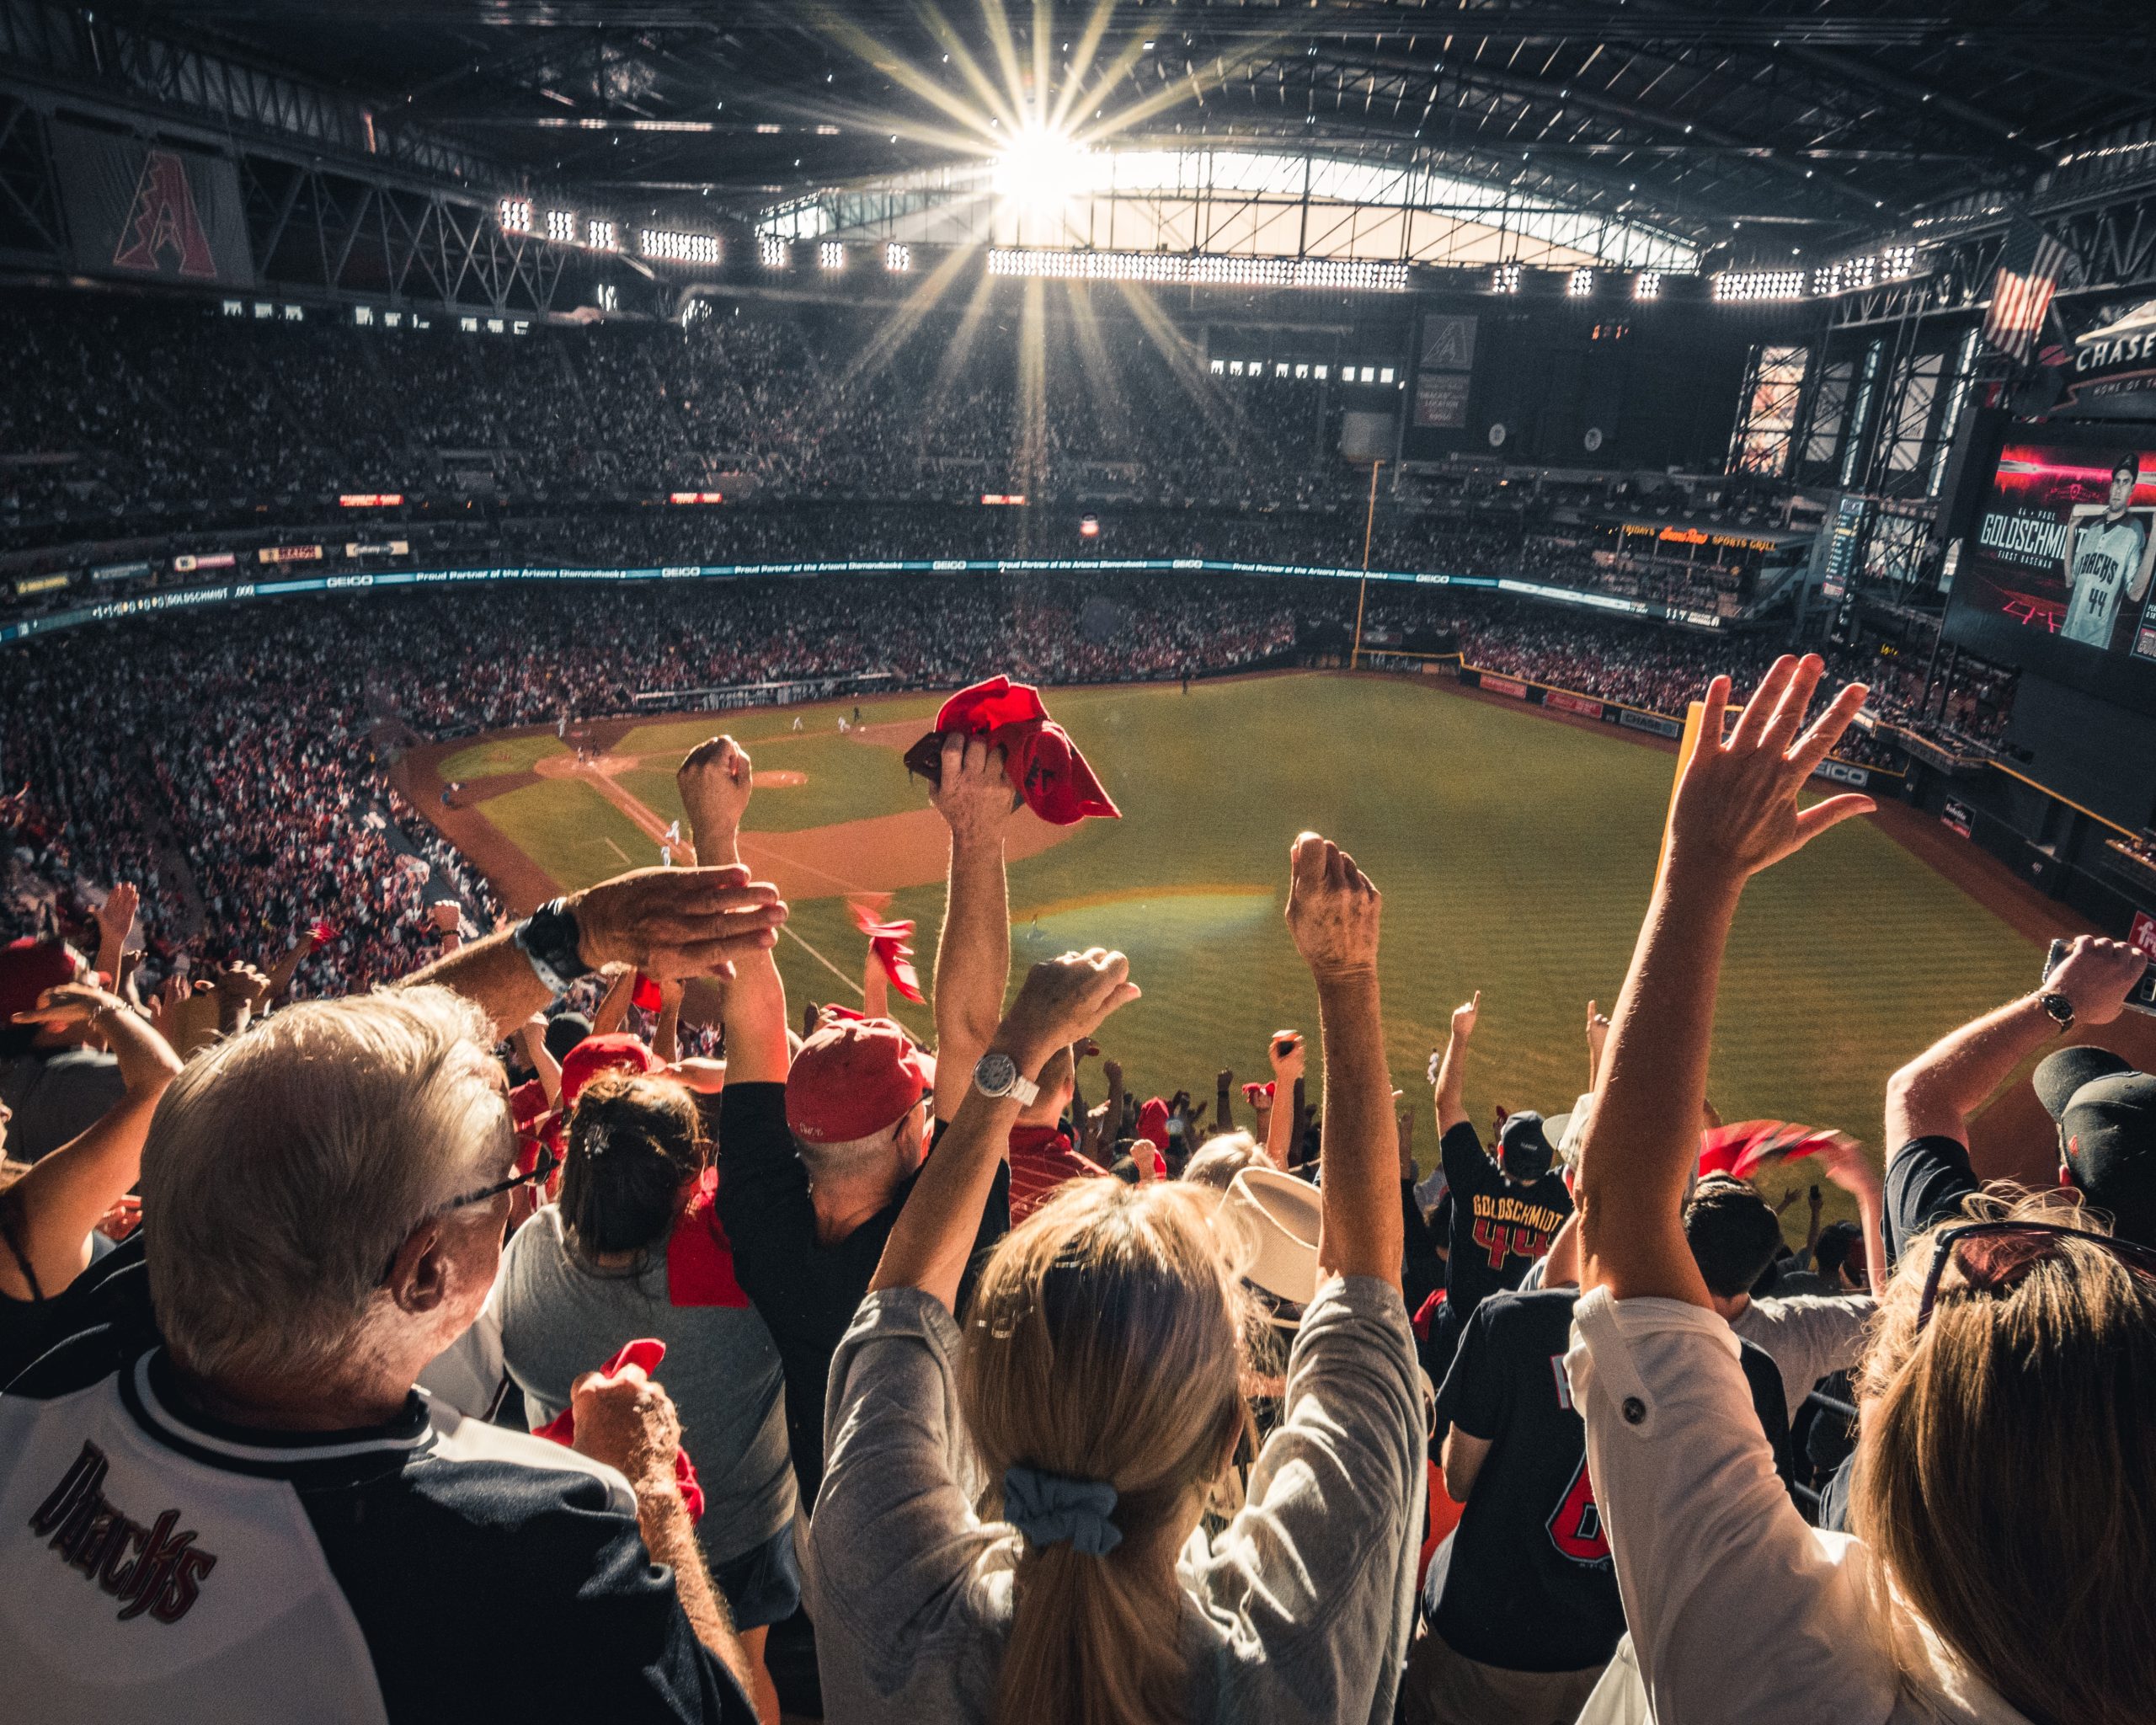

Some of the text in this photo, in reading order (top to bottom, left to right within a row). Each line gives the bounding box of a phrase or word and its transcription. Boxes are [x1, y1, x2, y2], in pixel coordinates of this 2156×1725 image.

[2075, 331, 2156, 372] CHASE
[2037, 510, 2056, 521] PAUL
[1712, 535, 1747, 548] SPORTS
[1980, 513, 2089, 561] GOLDSCHMIT
[932, 560, 967, 571] GEICO
[1172, 559, 1203, 569] GEICO
[1998, 550, 2053, 569] FIRST BASEMAN
[416, 570, 447, 582] Proud
[449, 569, 488, 581] Partner
[490, 569, 500, 579] of
[503, 569, 520, 578] the
[521, 568, 558, 579] Arizona
[662, 565, 701, 579] GEICO
[734, 564, 760, 574] Proud
[819, 562, 847, 571] Arizona
[1232, 563, 1255, 572] Proud
[1308, 567, 1336, 577] Arizona
[326, 574, 374, 589] GEICO
[1416, 573, 1449, 585] GEICO
[2089, 588, 2108, 617] 44
[1812, 761, 1867, 787] EICO
[1473, 1194, 1564, 1232] GOLDSCHMIDT
[1472, 1218, 1551, 1271] 44
